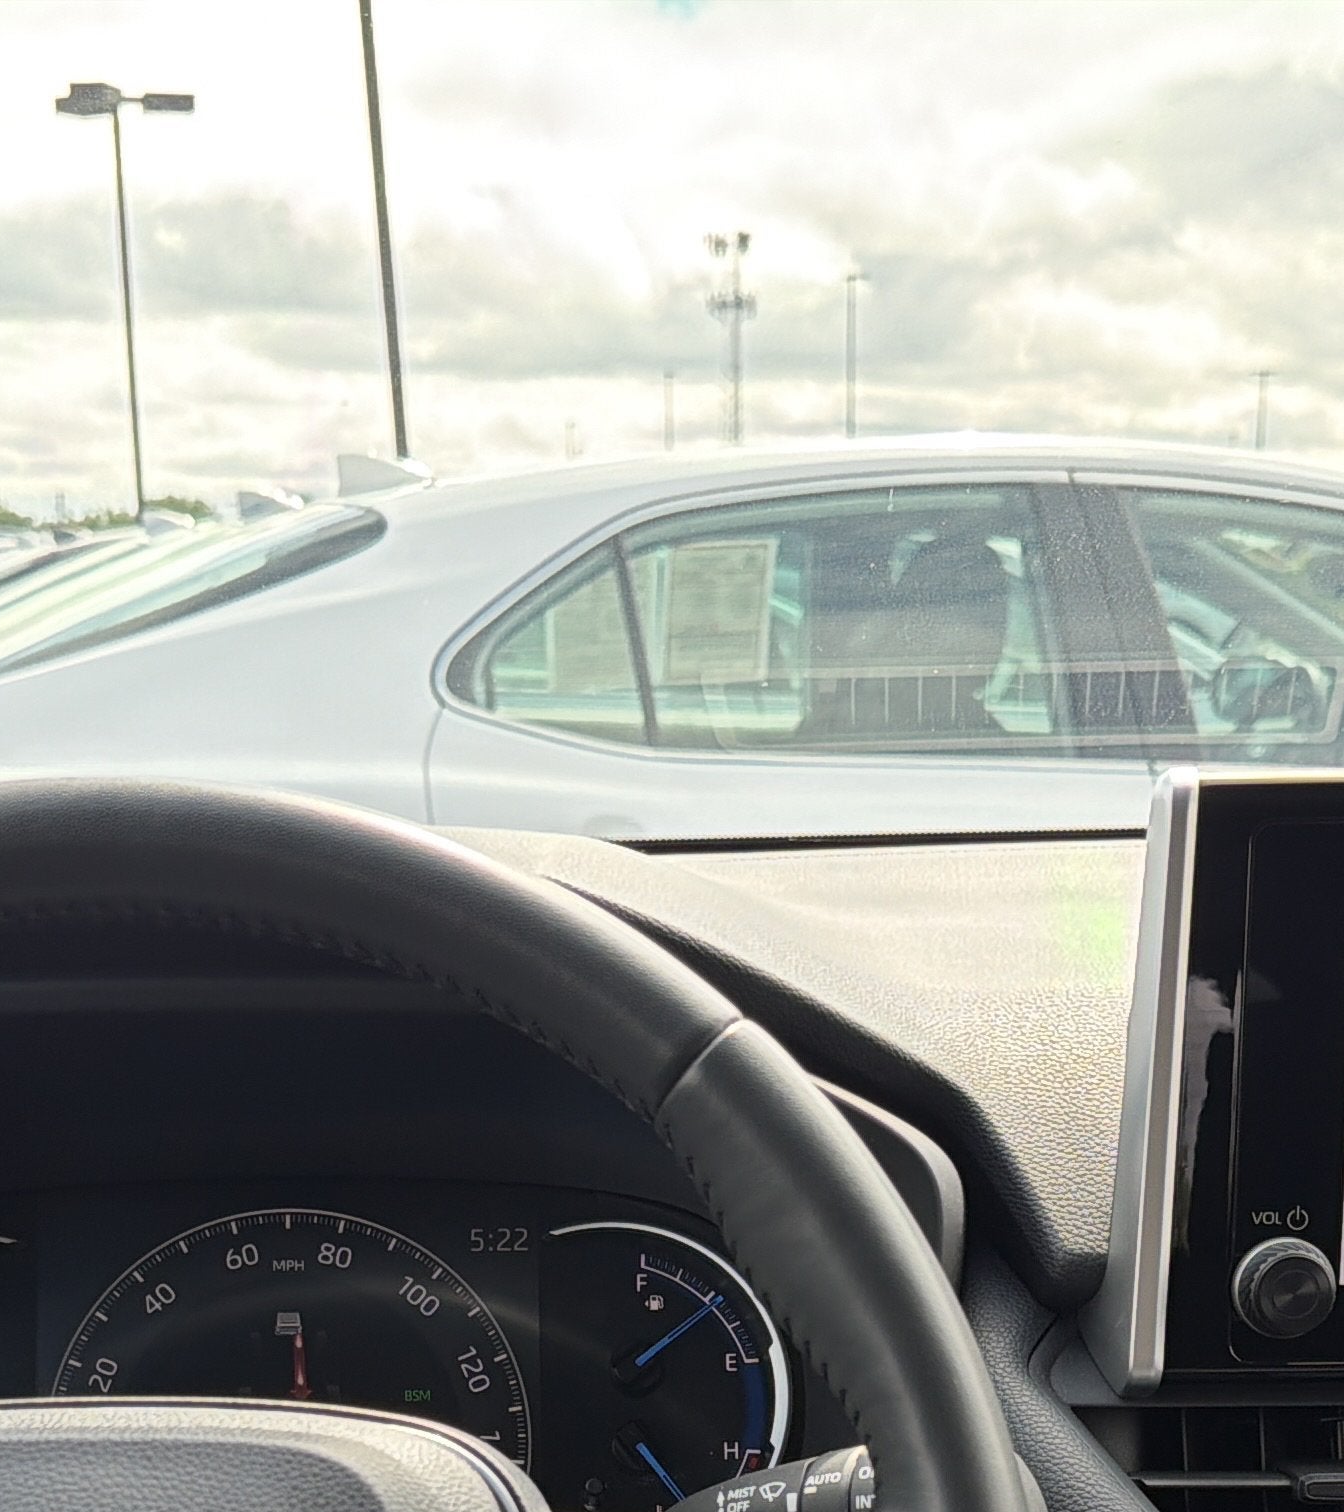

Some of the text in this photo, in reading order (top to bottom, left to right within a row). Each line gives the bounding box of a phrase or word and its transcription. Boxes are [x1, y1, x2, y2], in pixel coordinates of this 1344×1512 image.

[1251, 1211, 1282, 1225] VOL
[469, 1228, 529, 1253] 5:22
[225, 1243, 259, 1271] 60
[317, 1242, 352, 1269] 80
[272, 1259, 305, 1272] MPH
[635, 1273, 649, 1292] F
[143, 1282, 176, 1316] 40
[397, 1275, 442, 1317] 100
[457, 1345, 491, 1394] 120
[725, 1354, 738, 1372] E
[88, 1356, 119, 1394] 20
[404, 1390, 431, 1402] BSM
[722, 1442, 739, 1461] H
[804, 1471, 841, 1487] AUTO
[726, 1485, 757, 1502] MIST
